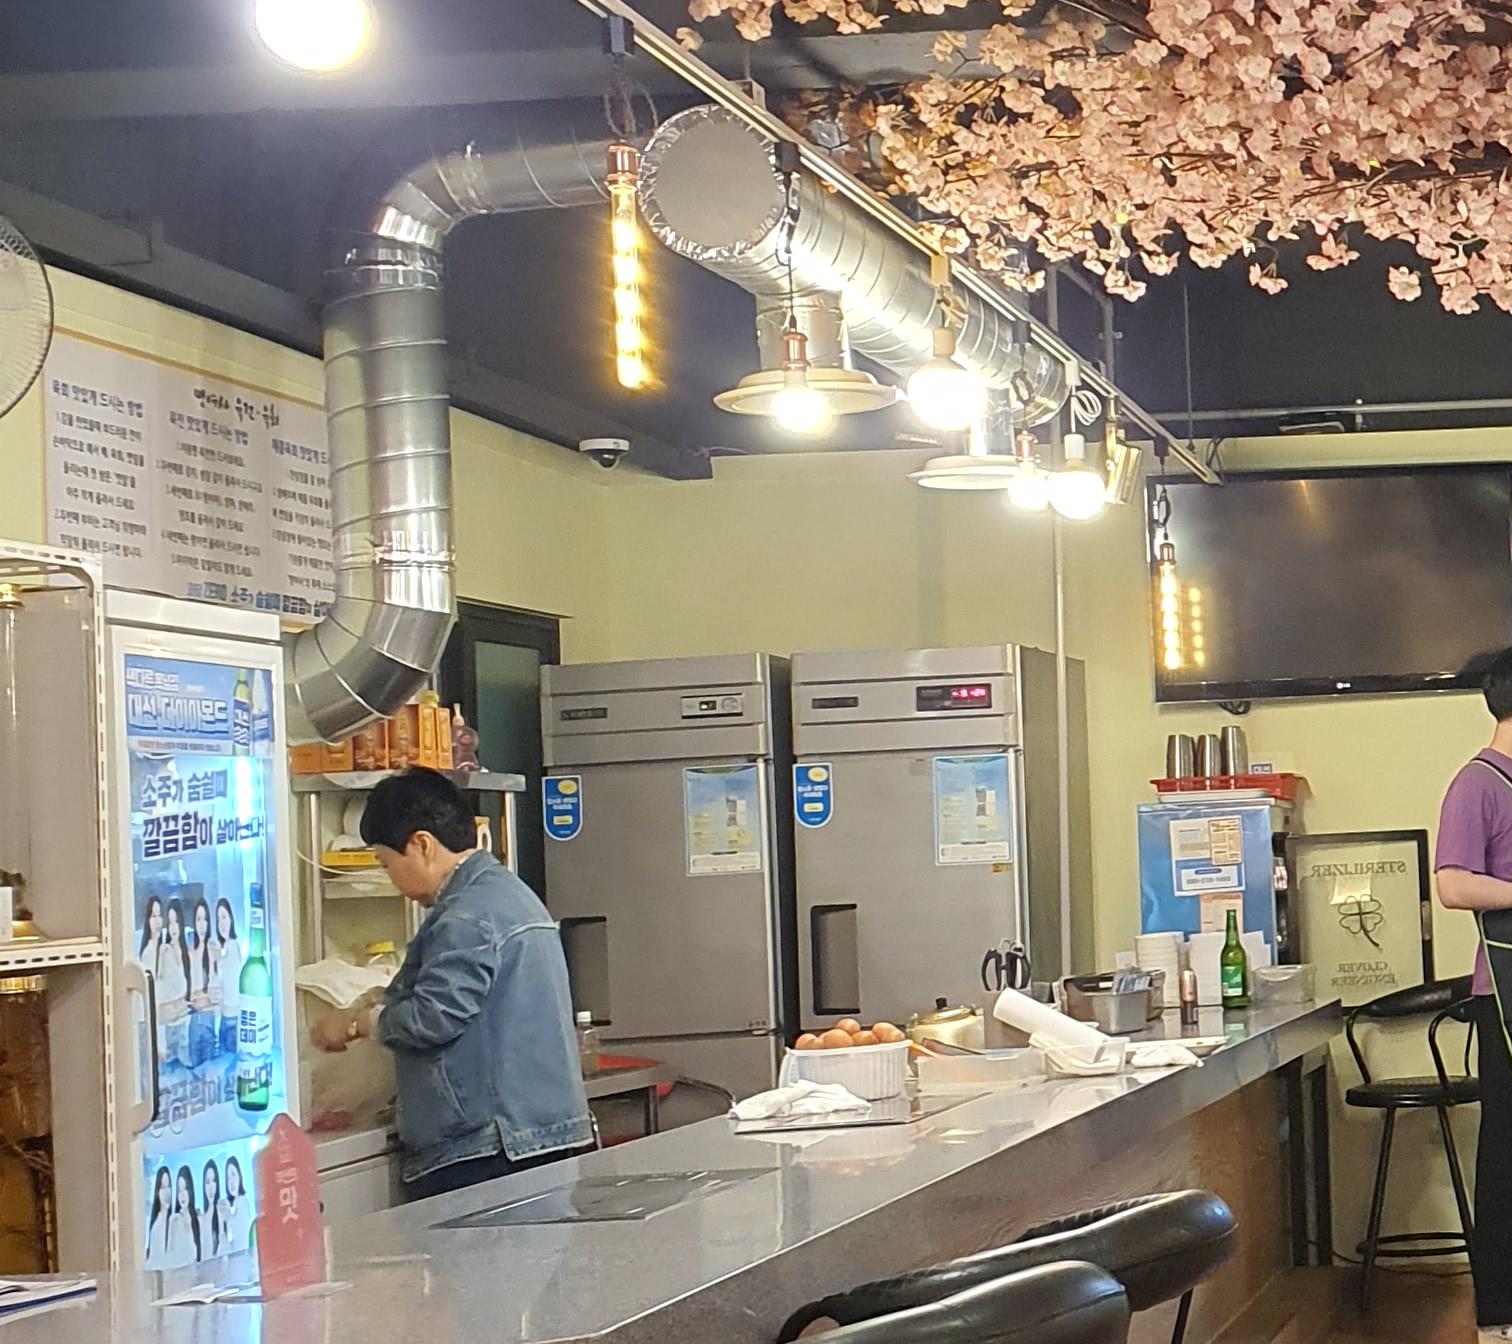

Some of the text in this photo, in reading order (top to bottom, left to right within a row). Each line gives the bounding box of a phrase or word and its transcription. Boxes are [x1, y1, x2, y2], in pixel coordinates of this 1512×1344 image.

[142, 769, 227, 809] 소주가 숨쉴때
[143, 811, 213, 858] 깔끔함이
